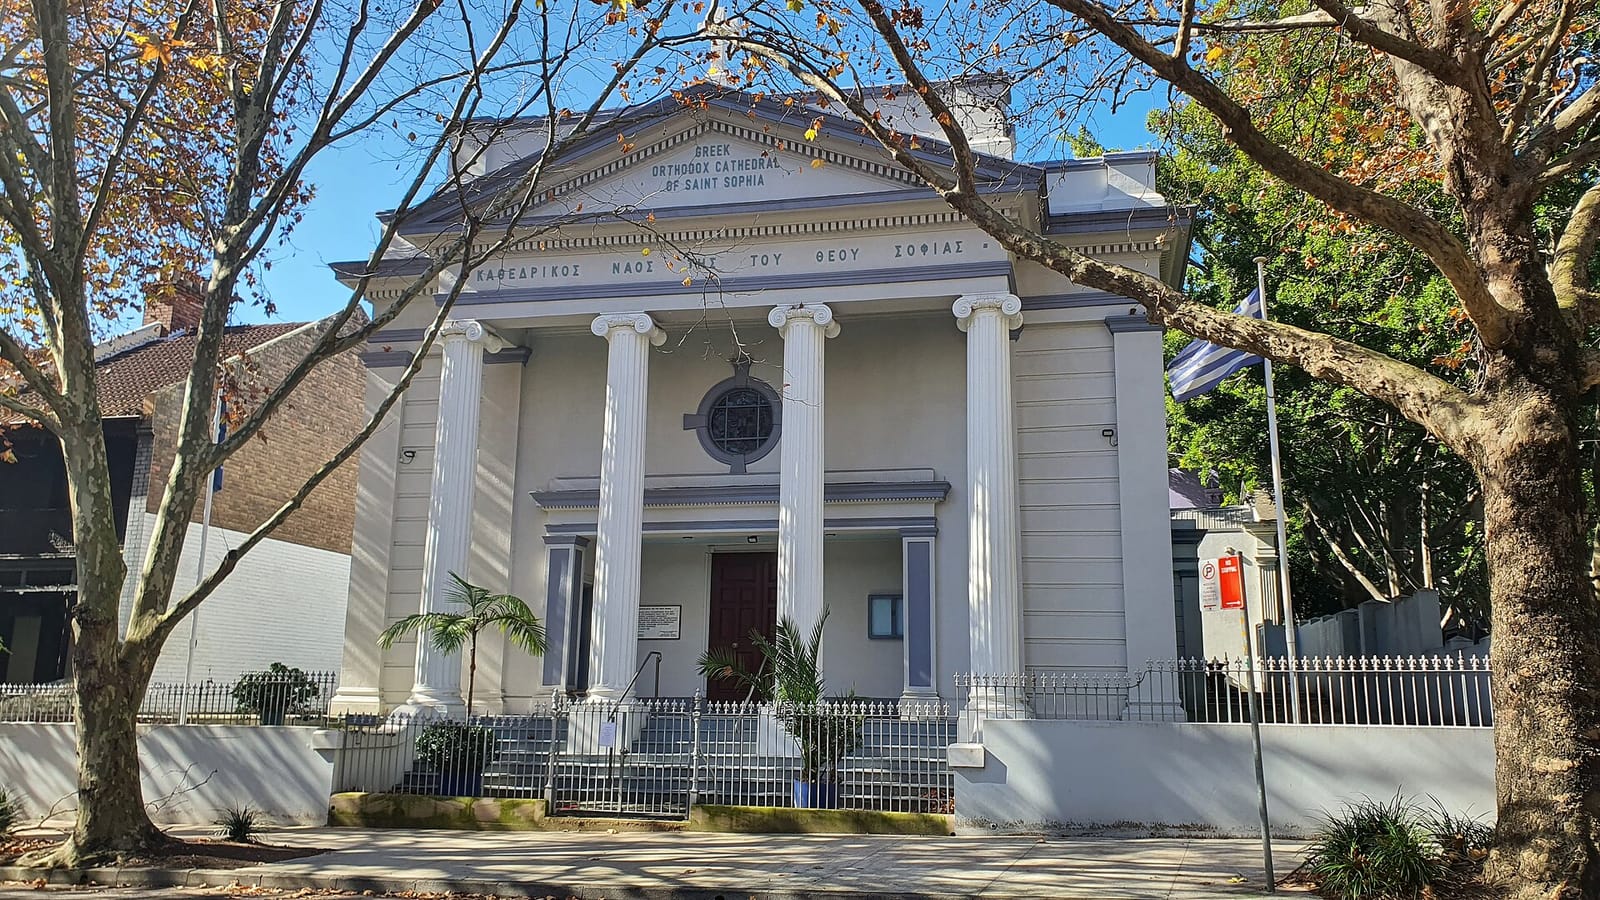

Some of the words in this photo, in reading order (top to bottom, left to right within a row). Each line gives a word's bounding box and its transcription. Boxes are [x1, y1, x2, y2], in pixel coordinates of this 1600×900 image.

[695, 144, 731, 158] GREEK
[652, 161, 710, 177] ORTHODOX
[715, 157, 780, 172] CATHEDRAL
[666, 180, 679, 192] OF
[685, 177, 718, 191] SAINT
[723, 174, 765, 188] SOPHIA
[476, 264, 580, 282] ΚΑΘΕΔΡΙΚΟΣ
[612, 260, 654, 274] ΝΑΟΣ
[750, 253, 782, 267] ΤΟΥ
[816, 247, 860, 263] ΘΕΟΥ
[894, 240, 964, 258] ΣΟΦΙΑΣ
